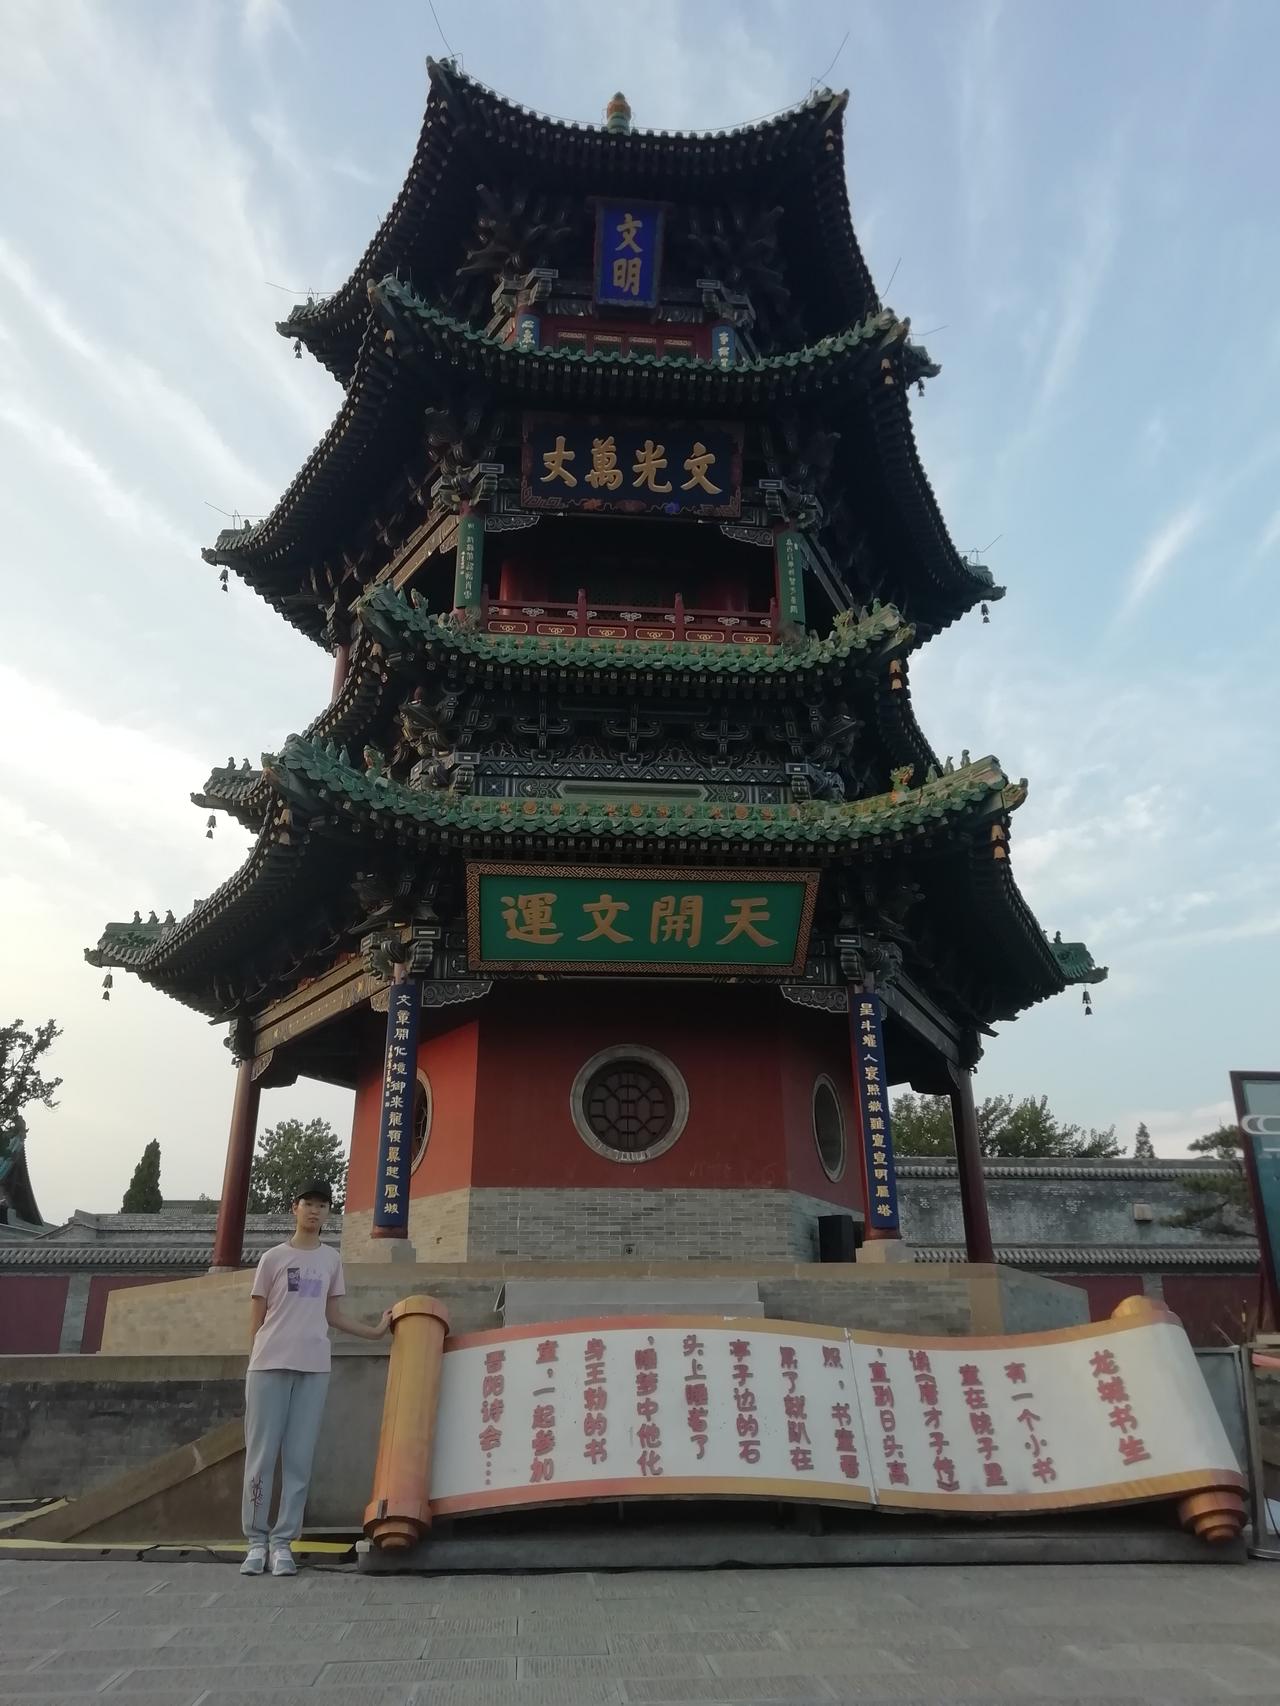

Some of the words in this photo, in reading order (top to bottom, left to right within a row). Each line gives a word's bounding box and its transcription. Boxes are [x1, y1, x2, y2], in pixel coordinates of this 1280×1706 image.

[613, 213, 644, 296] 文明
[500, 892, 779, 948] 天開文運
[583, 1338, 607, 1465] 身王勃的书
[683, 1334, 709, 1460] 头上睡着了
[729, 1339, 761, 1464] 亭子边的石
[779, 1345, 815, 1472] 累了就趴在
[958, 1363, 1008, 1487] 童在院子里
[1003, 1361, 1057, 1484] 有一个小书
[1089, 1349, 1151, 1466] 龙城书生
